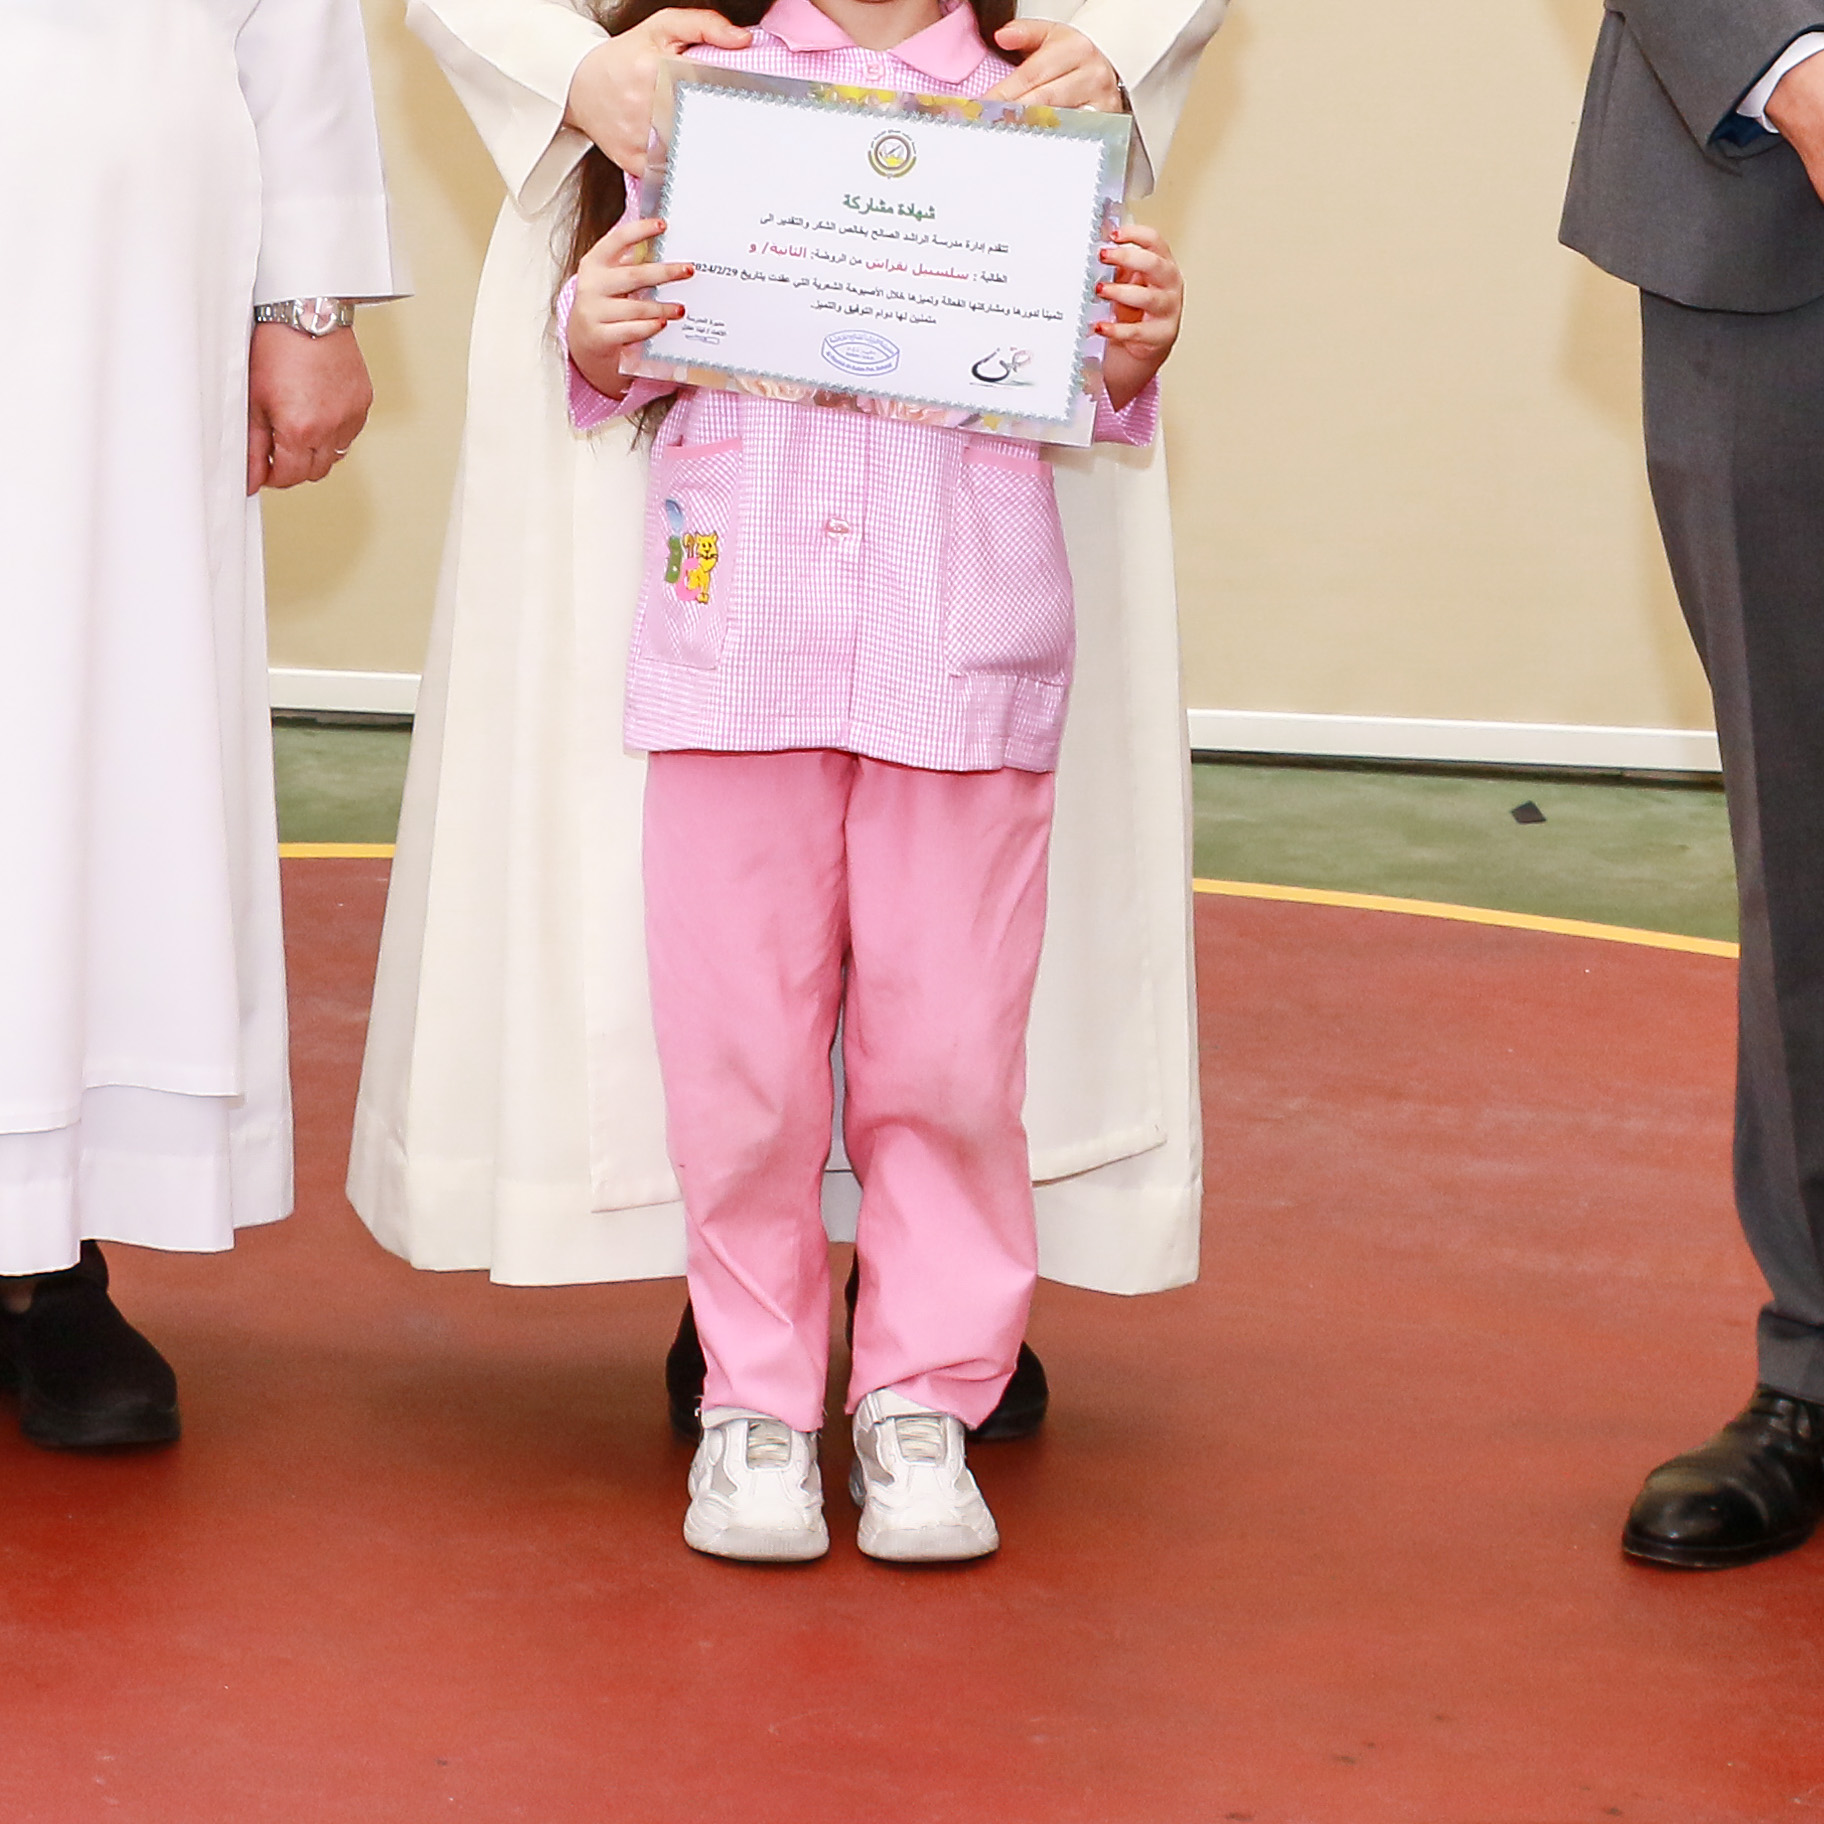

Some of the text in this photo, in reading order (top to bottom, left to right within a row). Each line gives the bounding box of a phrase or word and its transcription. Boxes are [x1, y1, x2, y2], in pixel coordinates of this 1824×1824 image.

[842, 193, 936, 222] شهادة مشاركة
[776, 216, 809, 229] والتقدير
[812, 221, 836, 230] الشكر
[839, 225, 868, 237] بخالص
[871, 228, 899, 240] الصالح
[932, 234, 962, 248] مدرسة
[849, 257, 862, 265] من
[691, 262, 738, 276] 024/2/29
[740, 270, 765, 281] بتاريخ
[793, 278, 810, 288] التي
